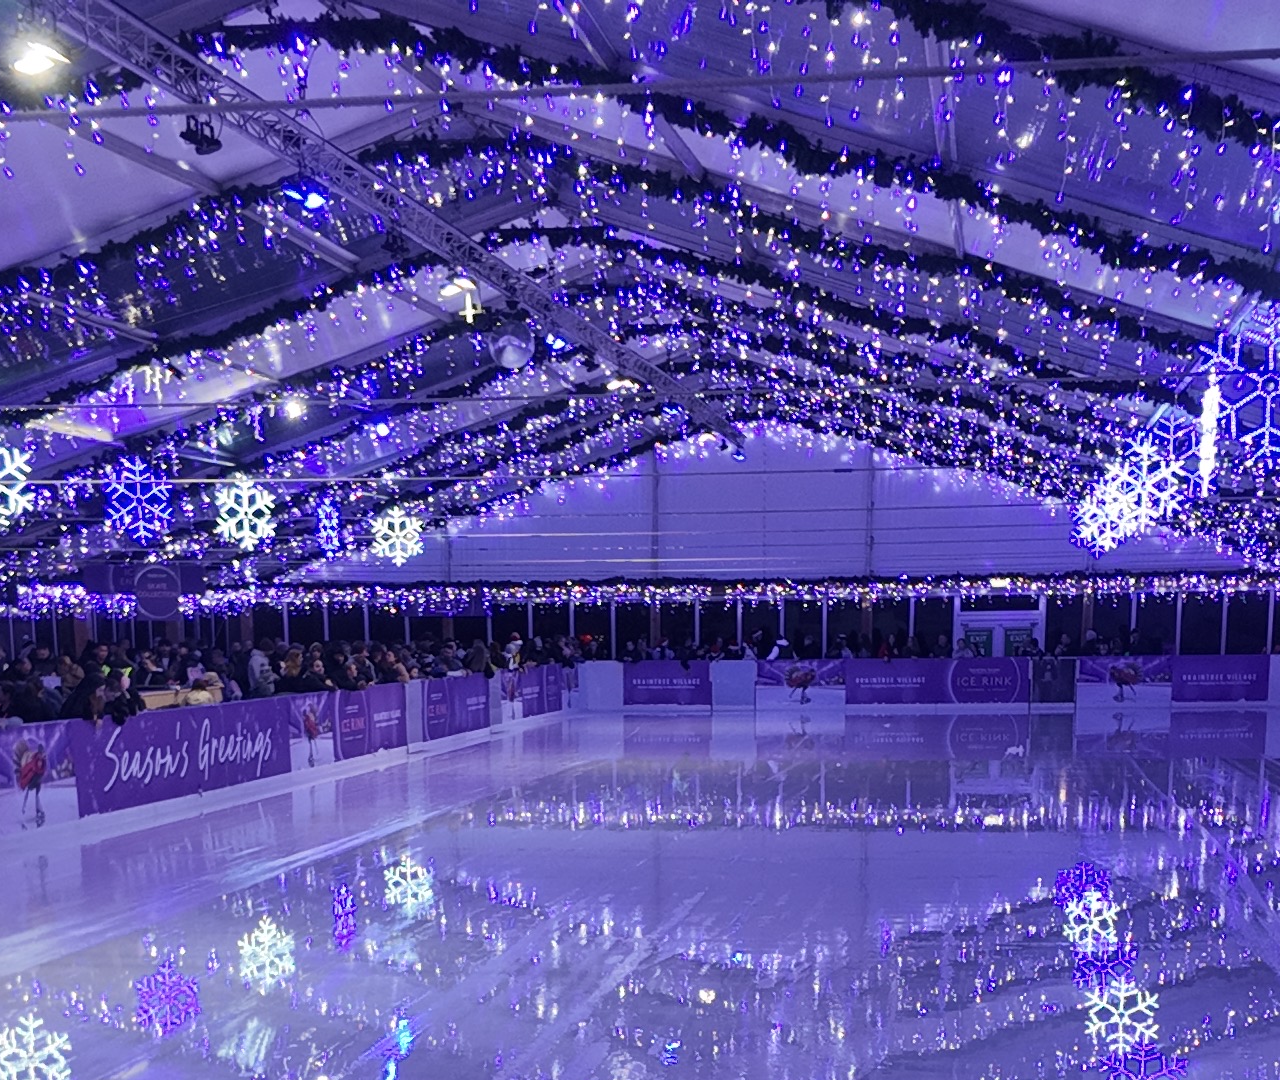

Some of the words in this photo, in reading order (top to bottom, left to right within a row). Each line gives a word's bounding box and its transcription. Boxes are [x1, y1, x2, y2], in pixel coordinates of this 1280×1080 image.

[957, 676, 977, 687] ICE
[982, 676, 1012, 687] RINK
[104, 720, 189, 792] Season's
[198, 717, 272, 781] Greetings
